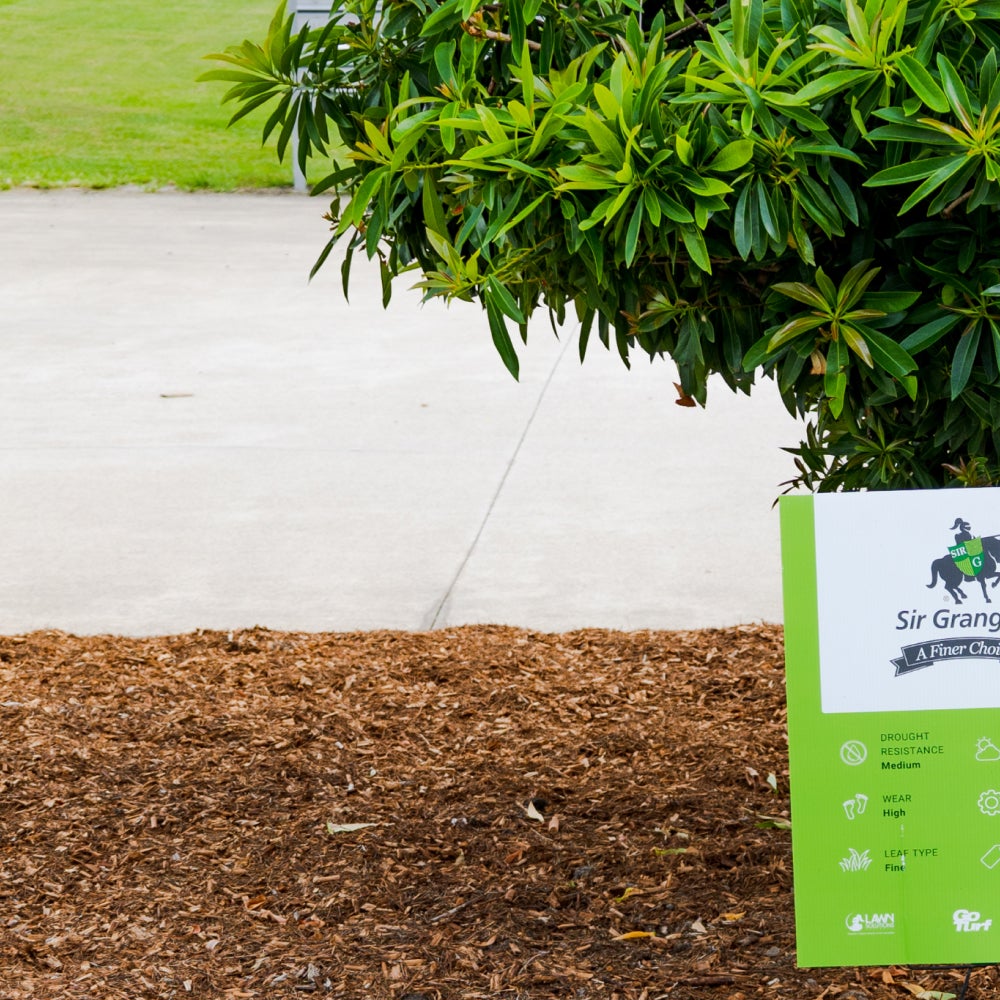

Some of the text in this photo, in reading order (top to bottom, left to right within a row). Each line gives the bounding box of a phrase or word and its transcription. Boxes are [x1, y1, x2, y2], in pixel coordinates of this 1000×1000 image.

[951, 547, 967, 558] SIR
[896, 610, 926, 630] Sir
[916, 648, 927, 660] A
[930, 644, 967, 659] Finer
[880, 732, 929, 741] DROUGHT
[881, 745, 944, 756] RESISTANCE
[882, 761, 921, 770] Medium
[883, 794, 912, 803] WEAR
[883, 808, 906, 818] High
[912, 849, 938, 857] TYPE
[885, 863, 906, 872] Fine
[865, 913, 895, 924] LAWN
[953, 909, 980, 921] Go
